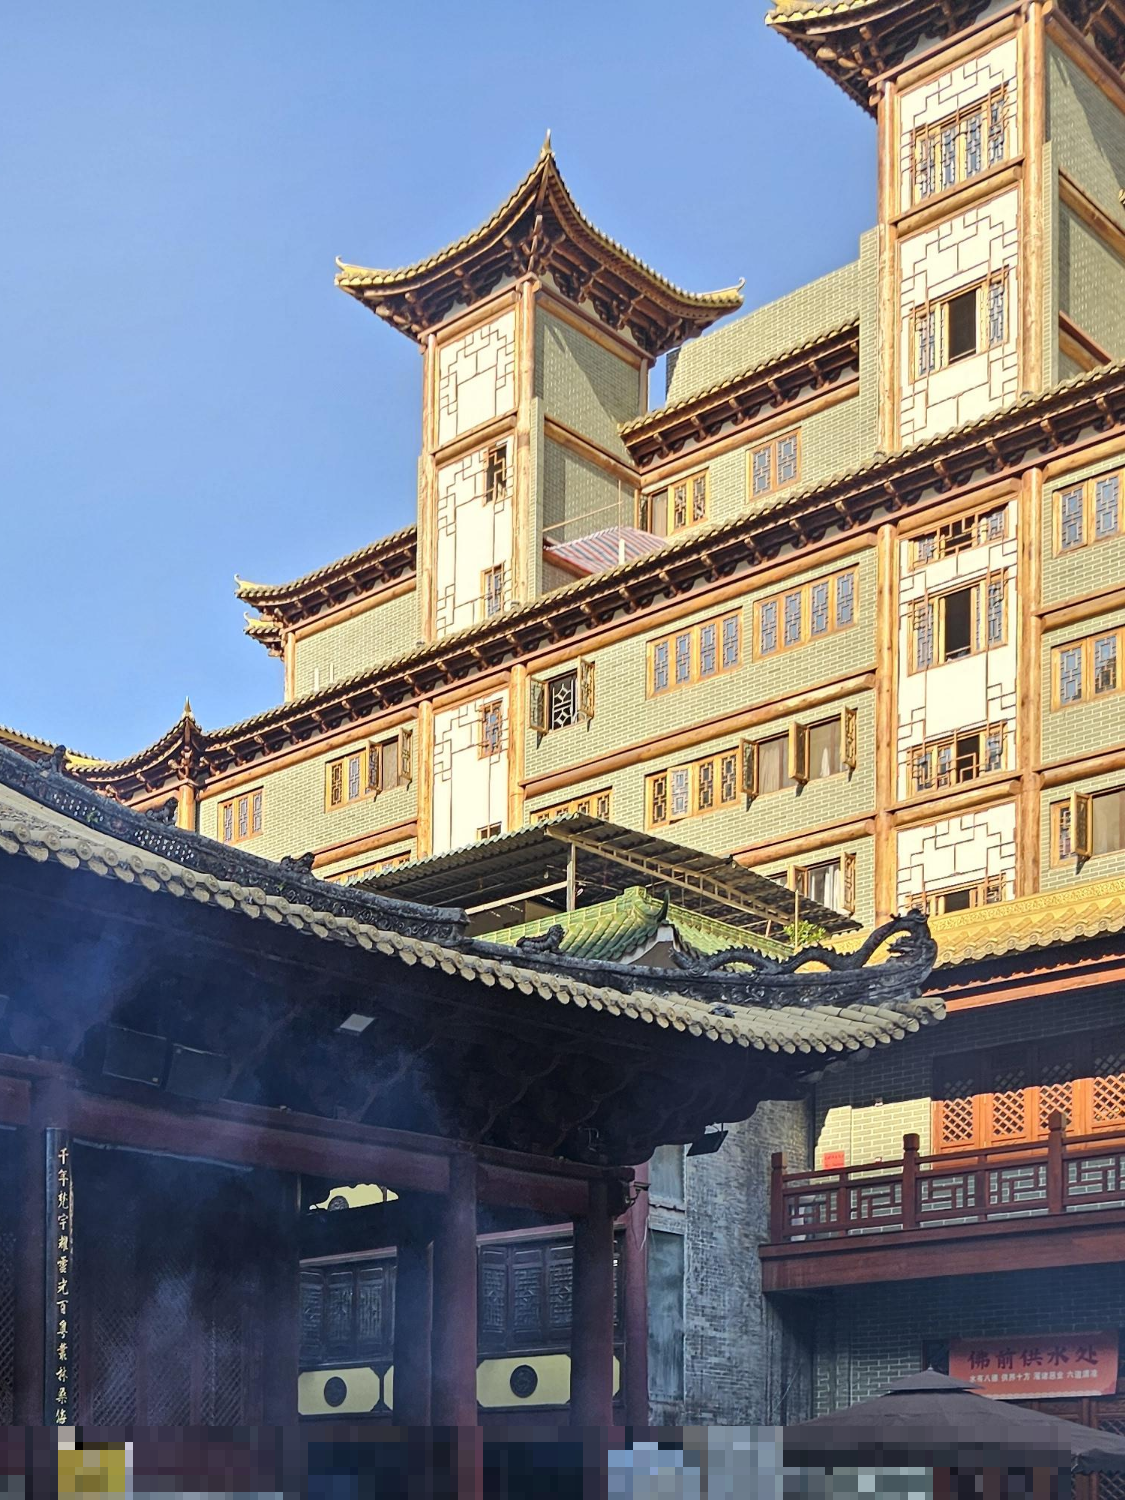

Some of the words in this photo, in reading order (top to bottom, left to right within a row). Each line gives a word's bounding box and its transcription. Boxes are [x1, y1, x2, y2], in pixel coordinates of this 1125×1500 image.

[968, 1346, 1099, 1370] 佛前供水处
